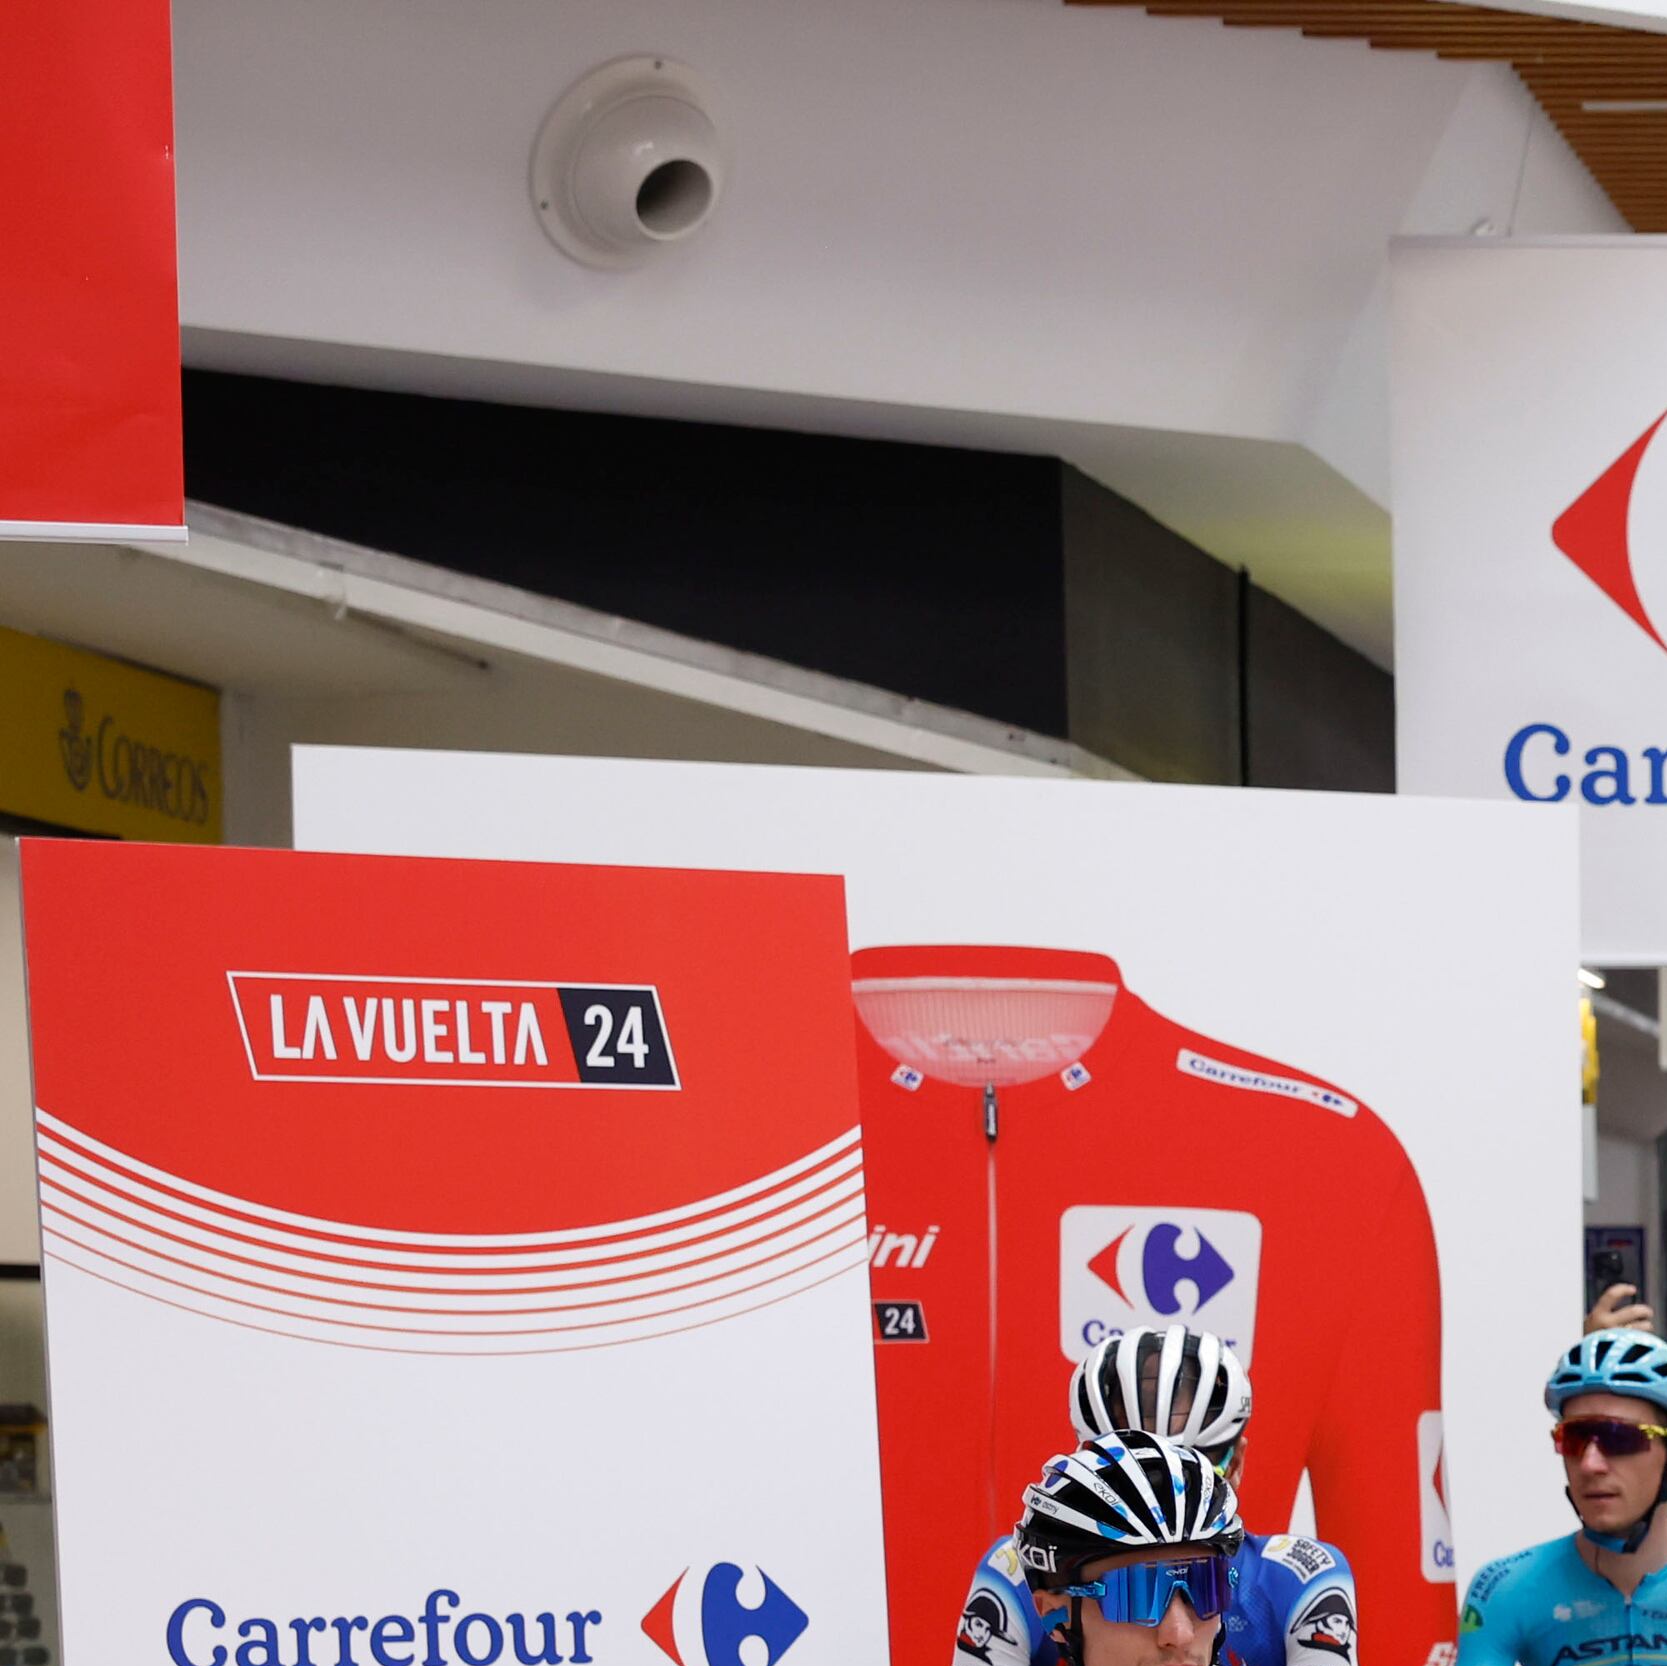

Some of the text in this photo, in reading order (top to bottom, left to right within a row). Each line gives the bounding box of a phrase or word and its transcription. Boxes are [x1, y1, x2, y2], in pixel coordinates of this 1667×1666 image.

[98, 714, 209, 824] CORREOS
[270, 993, 648, 1068] LA VUELTA 24
[887, 1307, 915, 1336] 24
